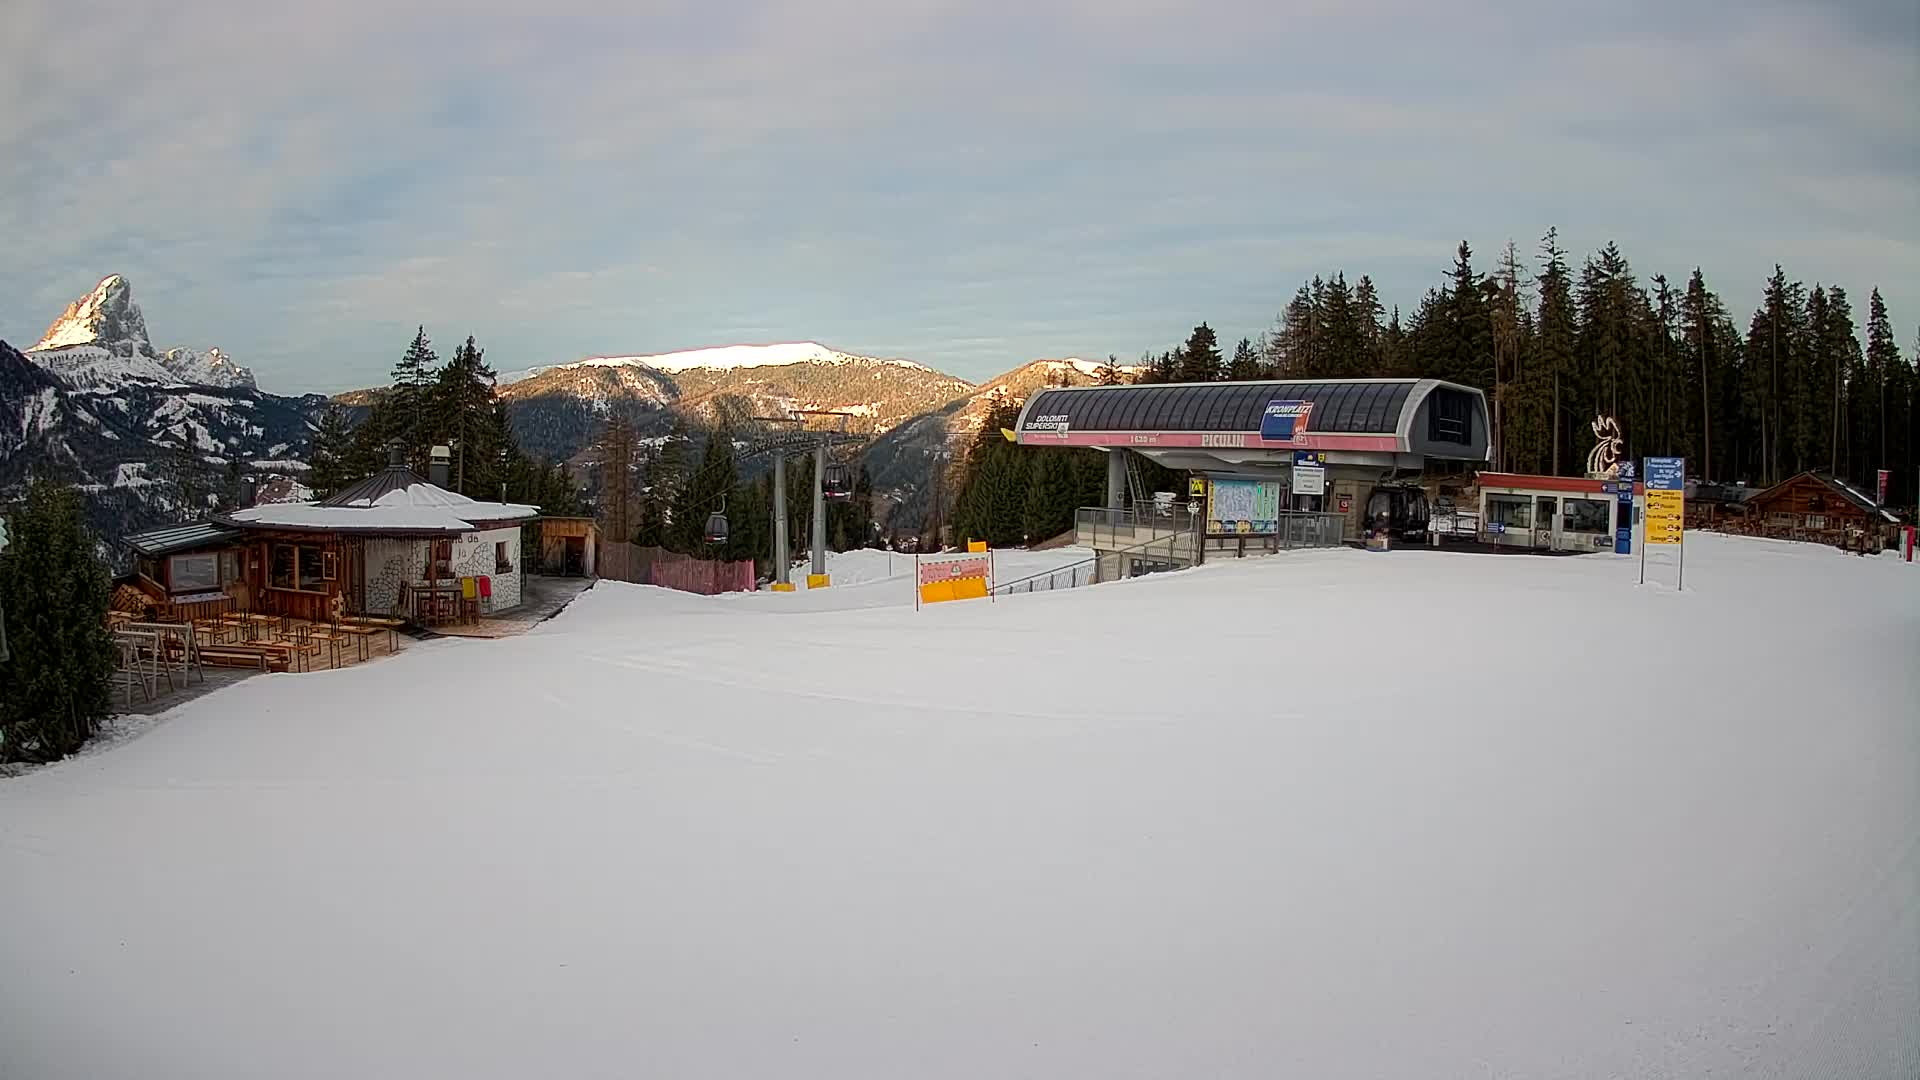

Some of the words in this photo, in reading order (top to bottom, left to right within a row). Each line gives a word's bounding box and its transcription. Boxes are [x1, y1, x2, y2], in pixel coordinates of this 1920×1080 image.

[1265, 405, 1313, 414] KRONPLATZ
[1036, 414, 1069, 422] DOLOMITI
[1025, 422, 1058, 430] SUPERSKI
[1201, 434, 1245, 448] PICULIN
